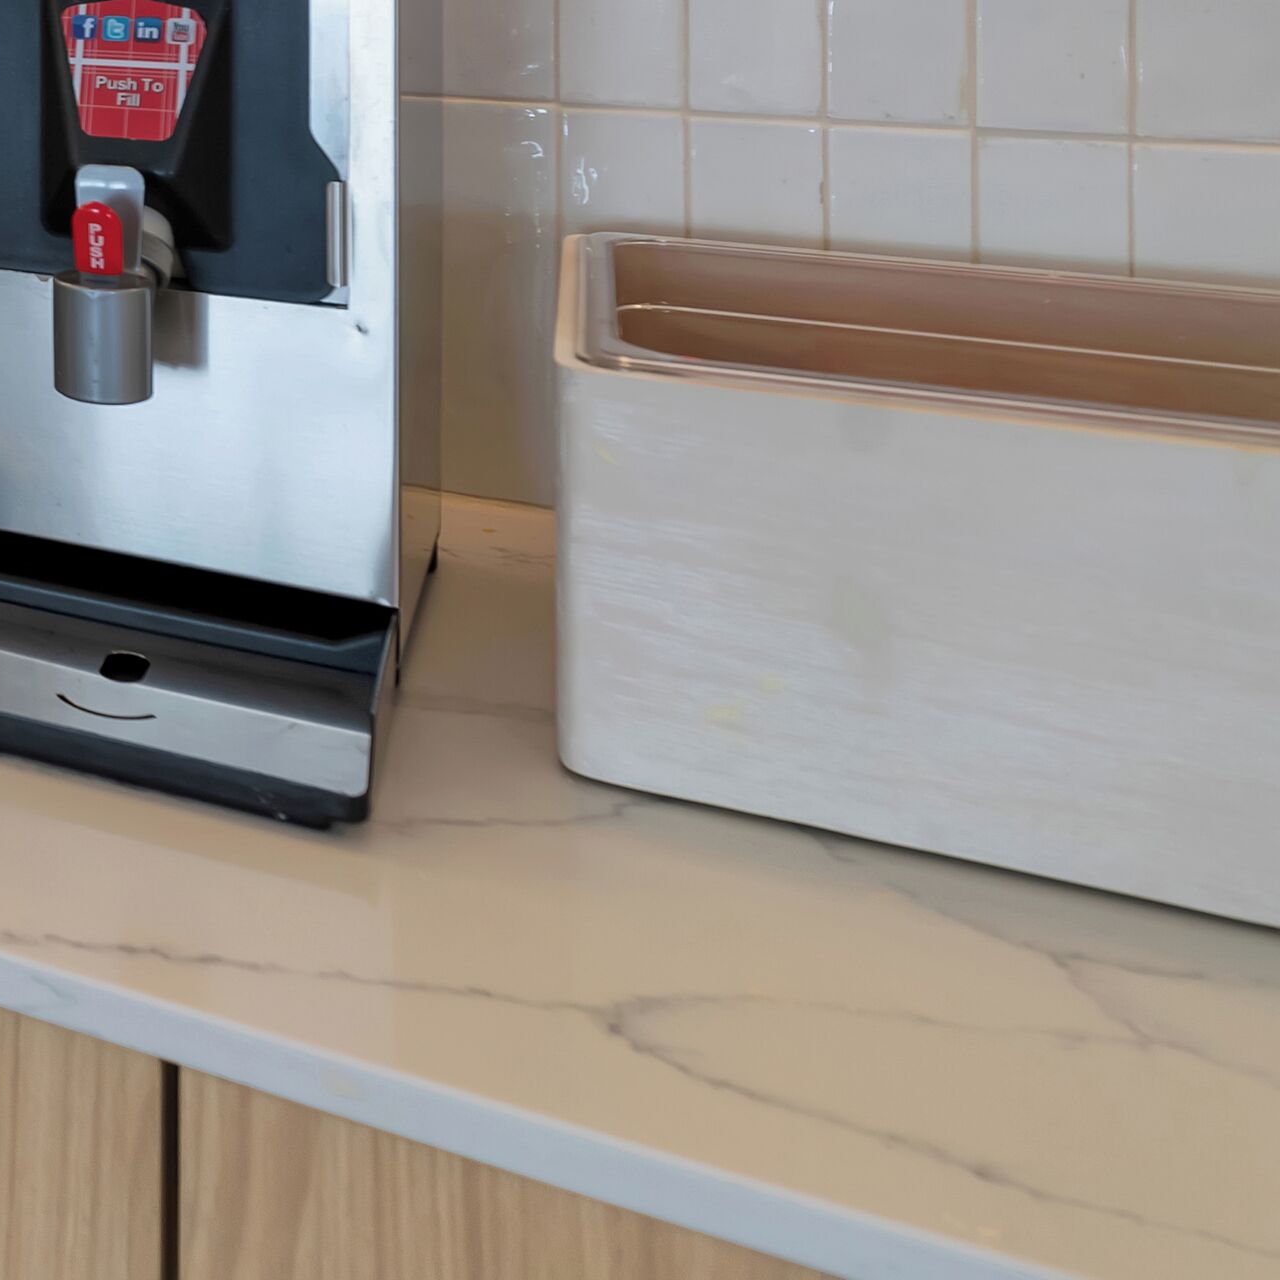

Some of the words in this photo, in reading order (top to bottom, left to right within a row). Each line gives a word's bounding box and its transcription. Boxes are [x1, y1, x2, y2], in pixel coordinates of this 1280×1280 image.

[96, 75, 137, 91] Push
[141, 78, 164, 93] To
[116, 92, 140, 107] Fill
[87, 222, 105, 269] PUSH
